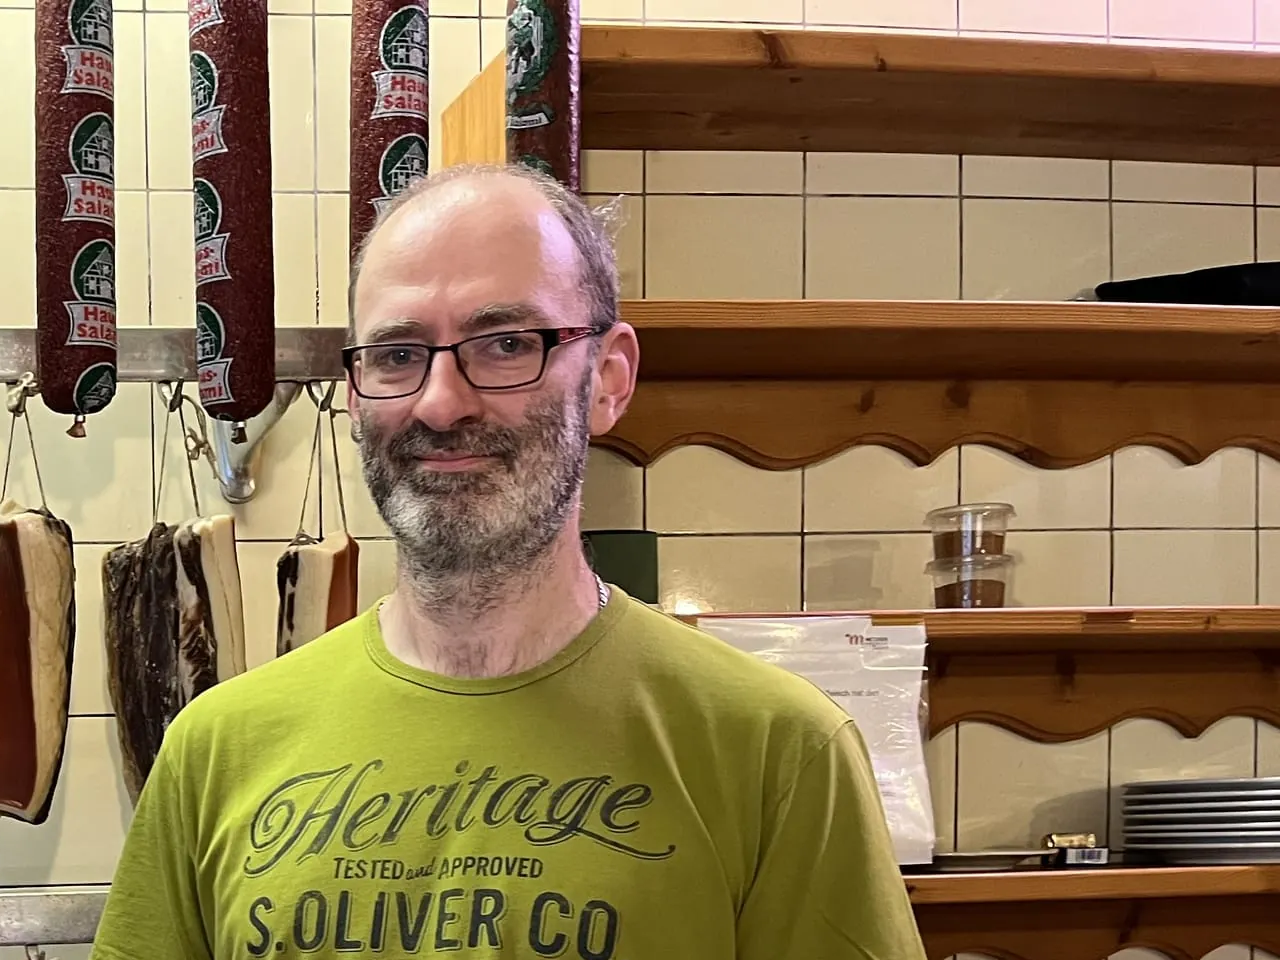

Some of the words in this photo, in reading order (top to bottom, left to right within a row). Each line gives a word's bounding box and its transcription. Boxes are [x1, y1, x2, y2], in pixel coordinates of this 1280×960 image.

[243, 759, 676, 878] Heritage
[333, 857, 404, 880] TESTED
[406, 857, 437, 880] and
[437, 857, 543, 879] APPROVED
